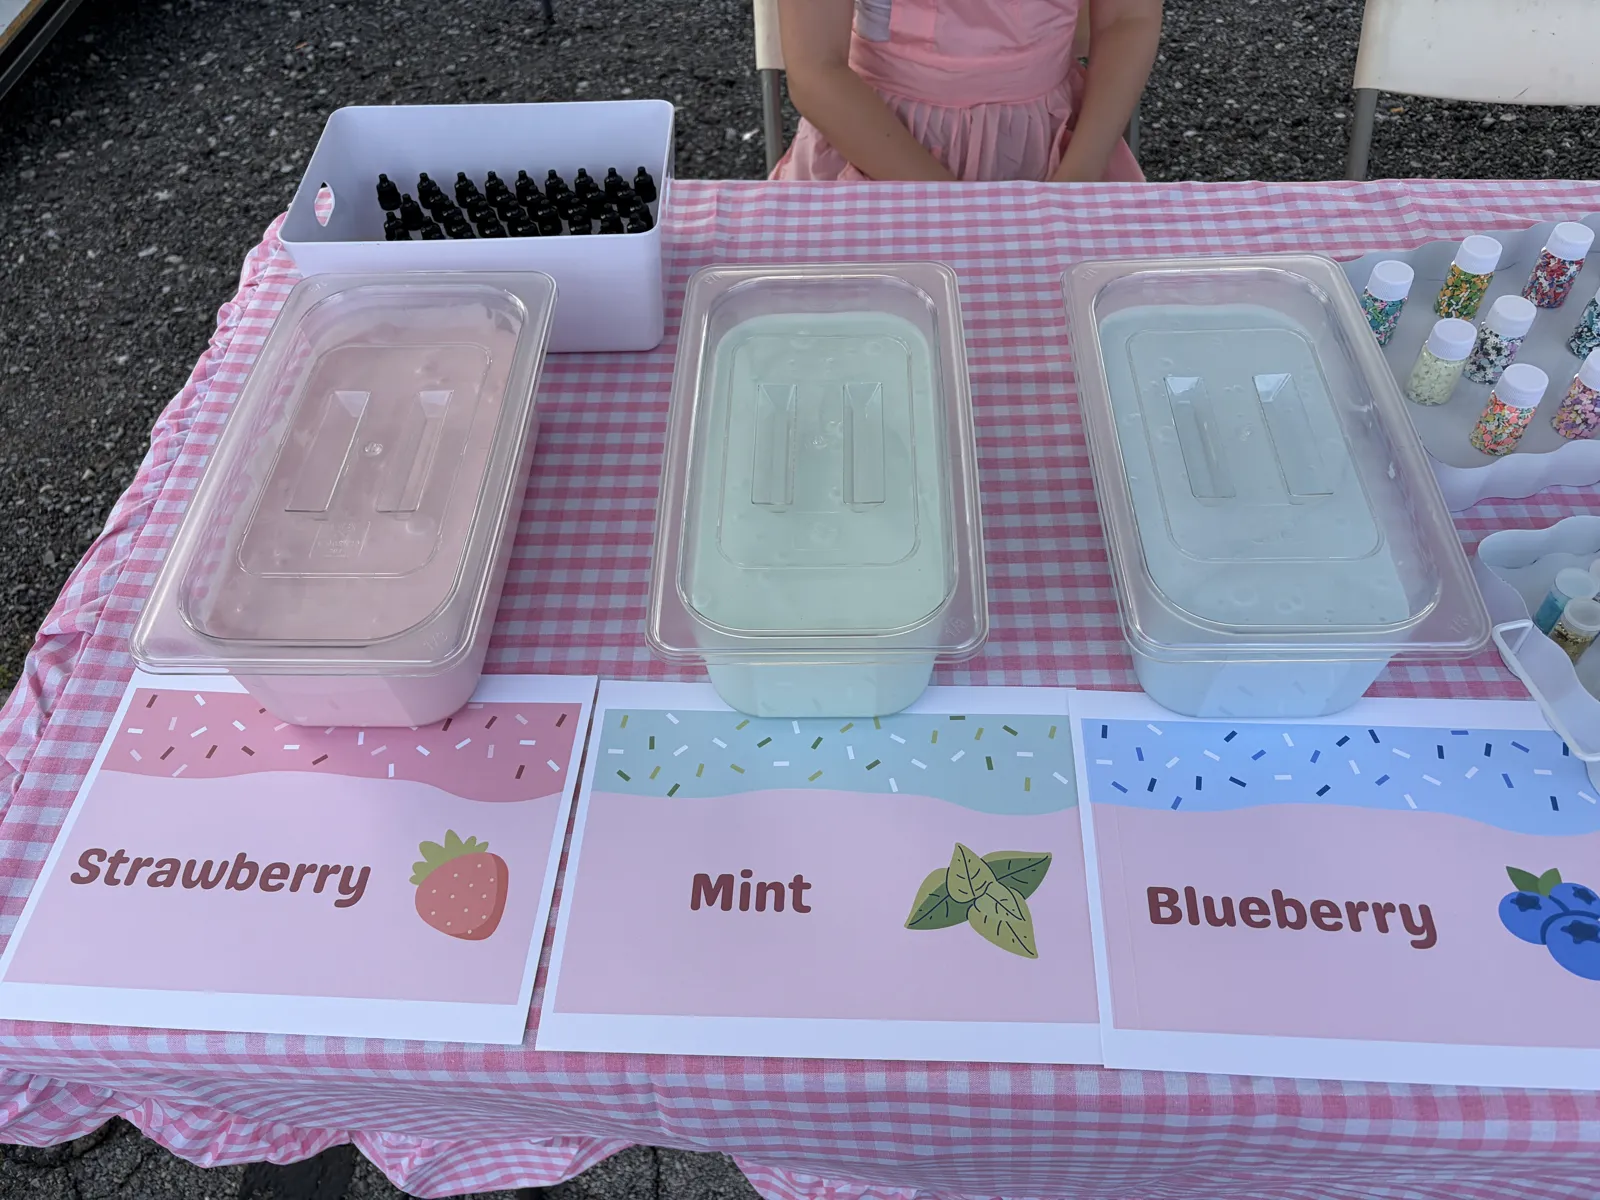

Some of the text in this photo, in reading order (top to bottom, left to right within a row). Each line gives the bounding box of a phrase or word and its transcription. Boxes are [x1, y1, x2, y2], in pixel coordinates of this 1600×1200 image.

[70, 847, 372, 908] Strawberry
[691, 868, 812, 914] Mint
[1147, 885, 1438, 950] Blueberry
